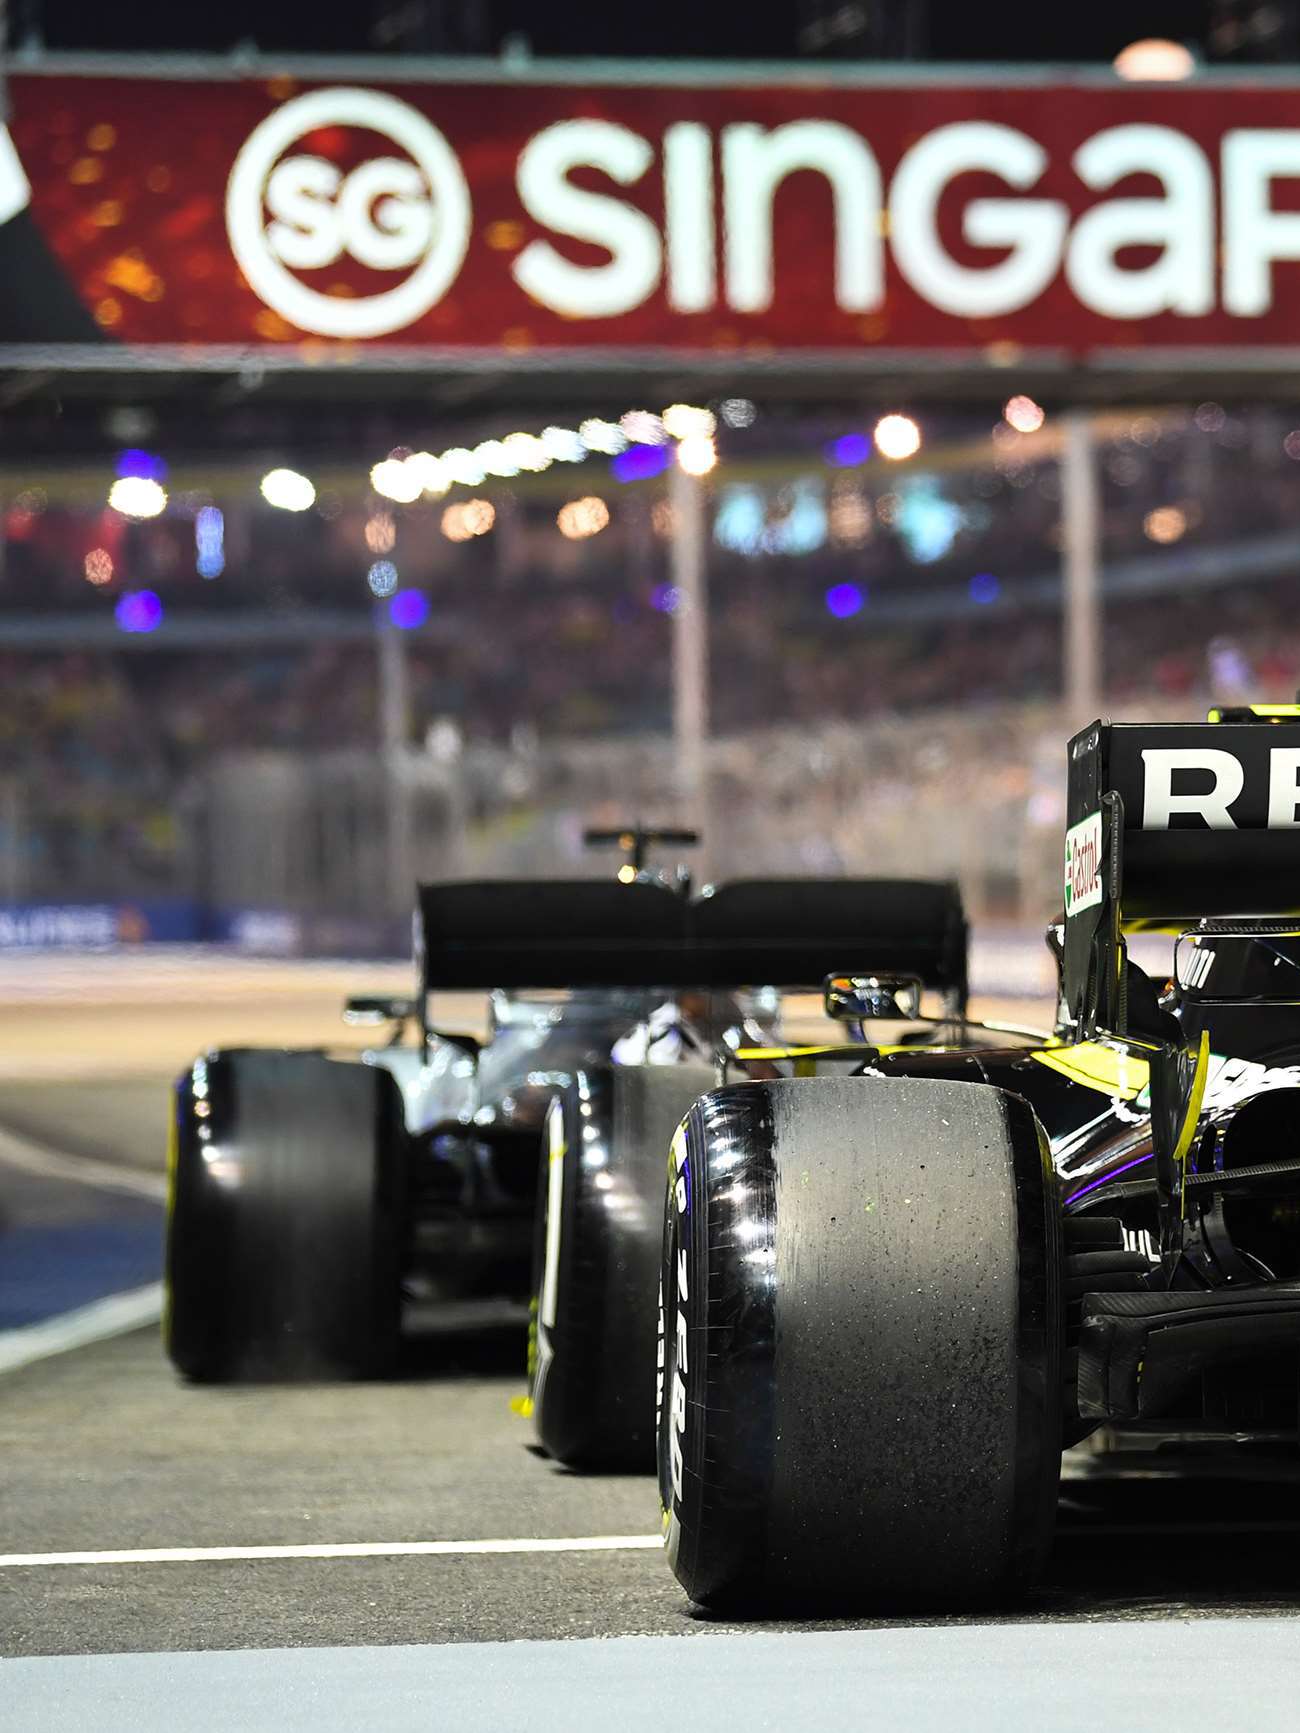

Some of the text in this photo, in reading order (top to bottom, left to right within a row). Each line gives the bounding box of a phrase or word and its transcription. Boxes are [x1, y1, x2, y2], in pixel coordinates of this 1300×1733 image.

[264, 154, 432, 270] SG
[1072, 826, 1099, 903] Castrol
[670, 1247, 690, 1503] ZERO
